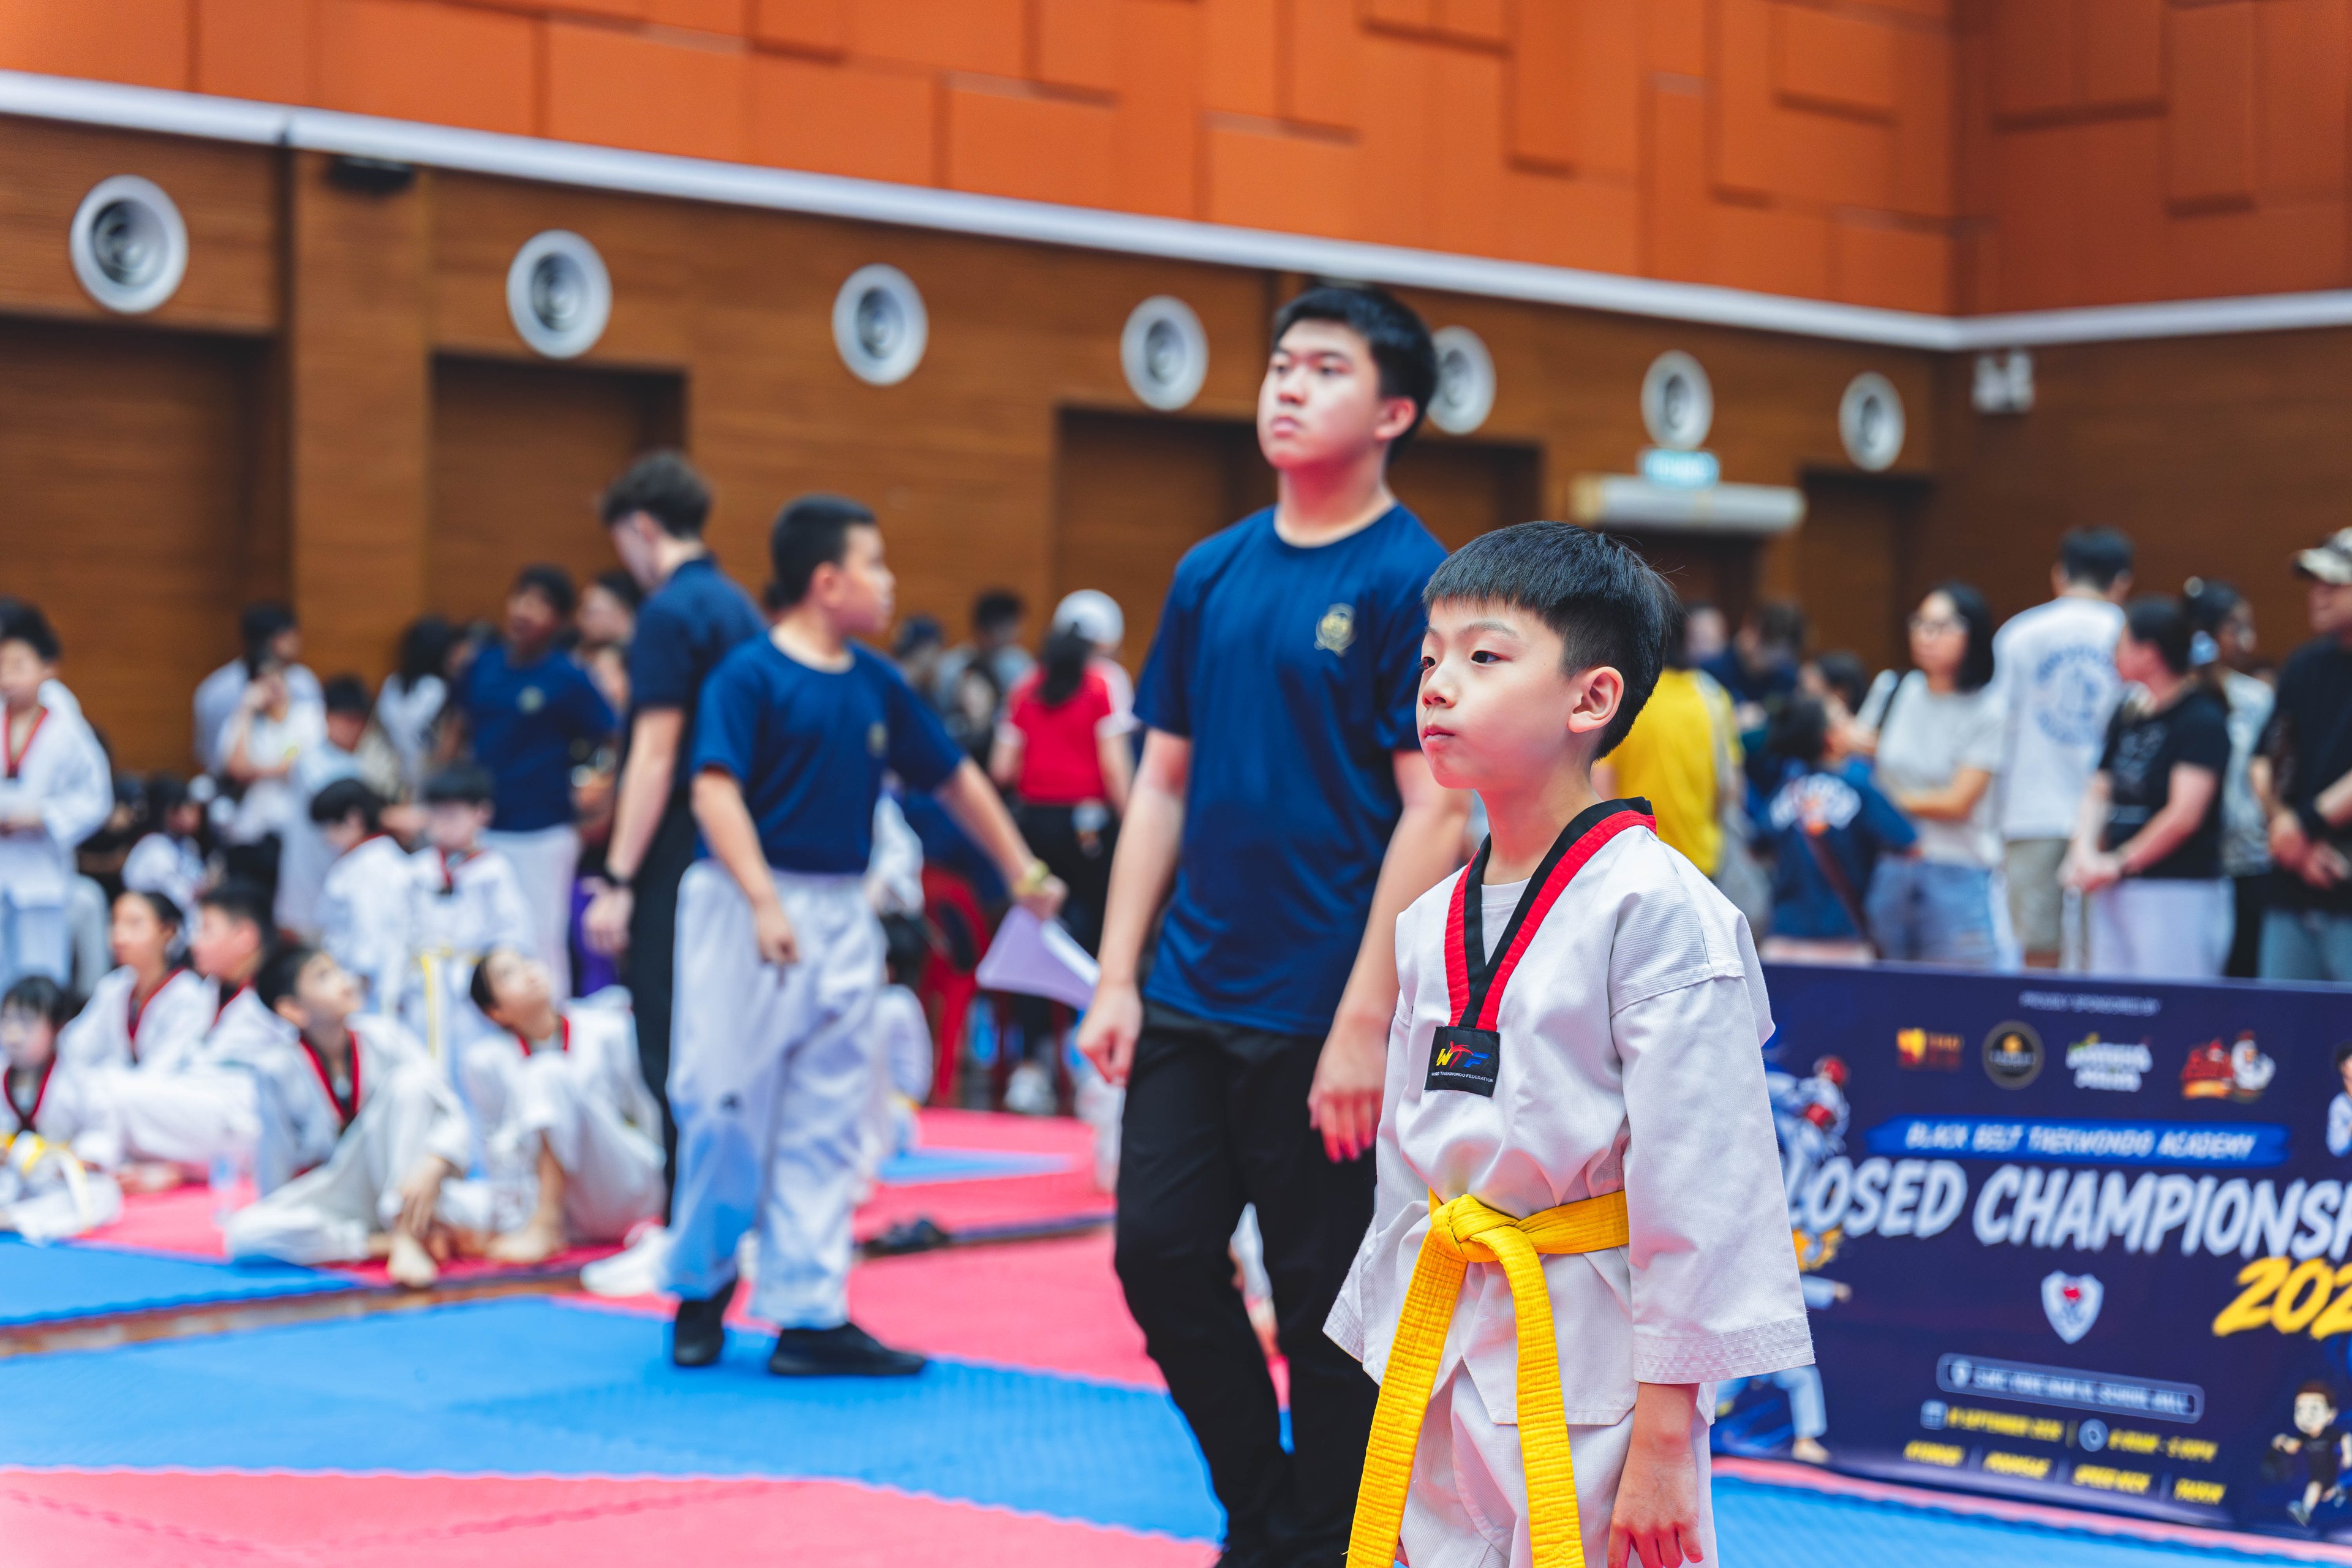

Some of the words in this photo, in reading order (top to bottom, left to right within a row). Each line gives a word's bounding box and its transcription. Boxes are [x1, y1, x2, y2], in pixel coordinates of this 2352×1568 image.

[1436, 1040, 1490, 1069] WTF
[1466, 1074, 1493, 1083] FEDERATION
[1905, 1121, 1969, 1150] BLACK
[1972, 1123, 2024, 1153] BELT
[2027, 1125, 2156, 1158] TAEKWONDO
[2156, 1130, 2258, 1161] ACADEMY
[1781, 1155, 1969, 1240] LOSED
